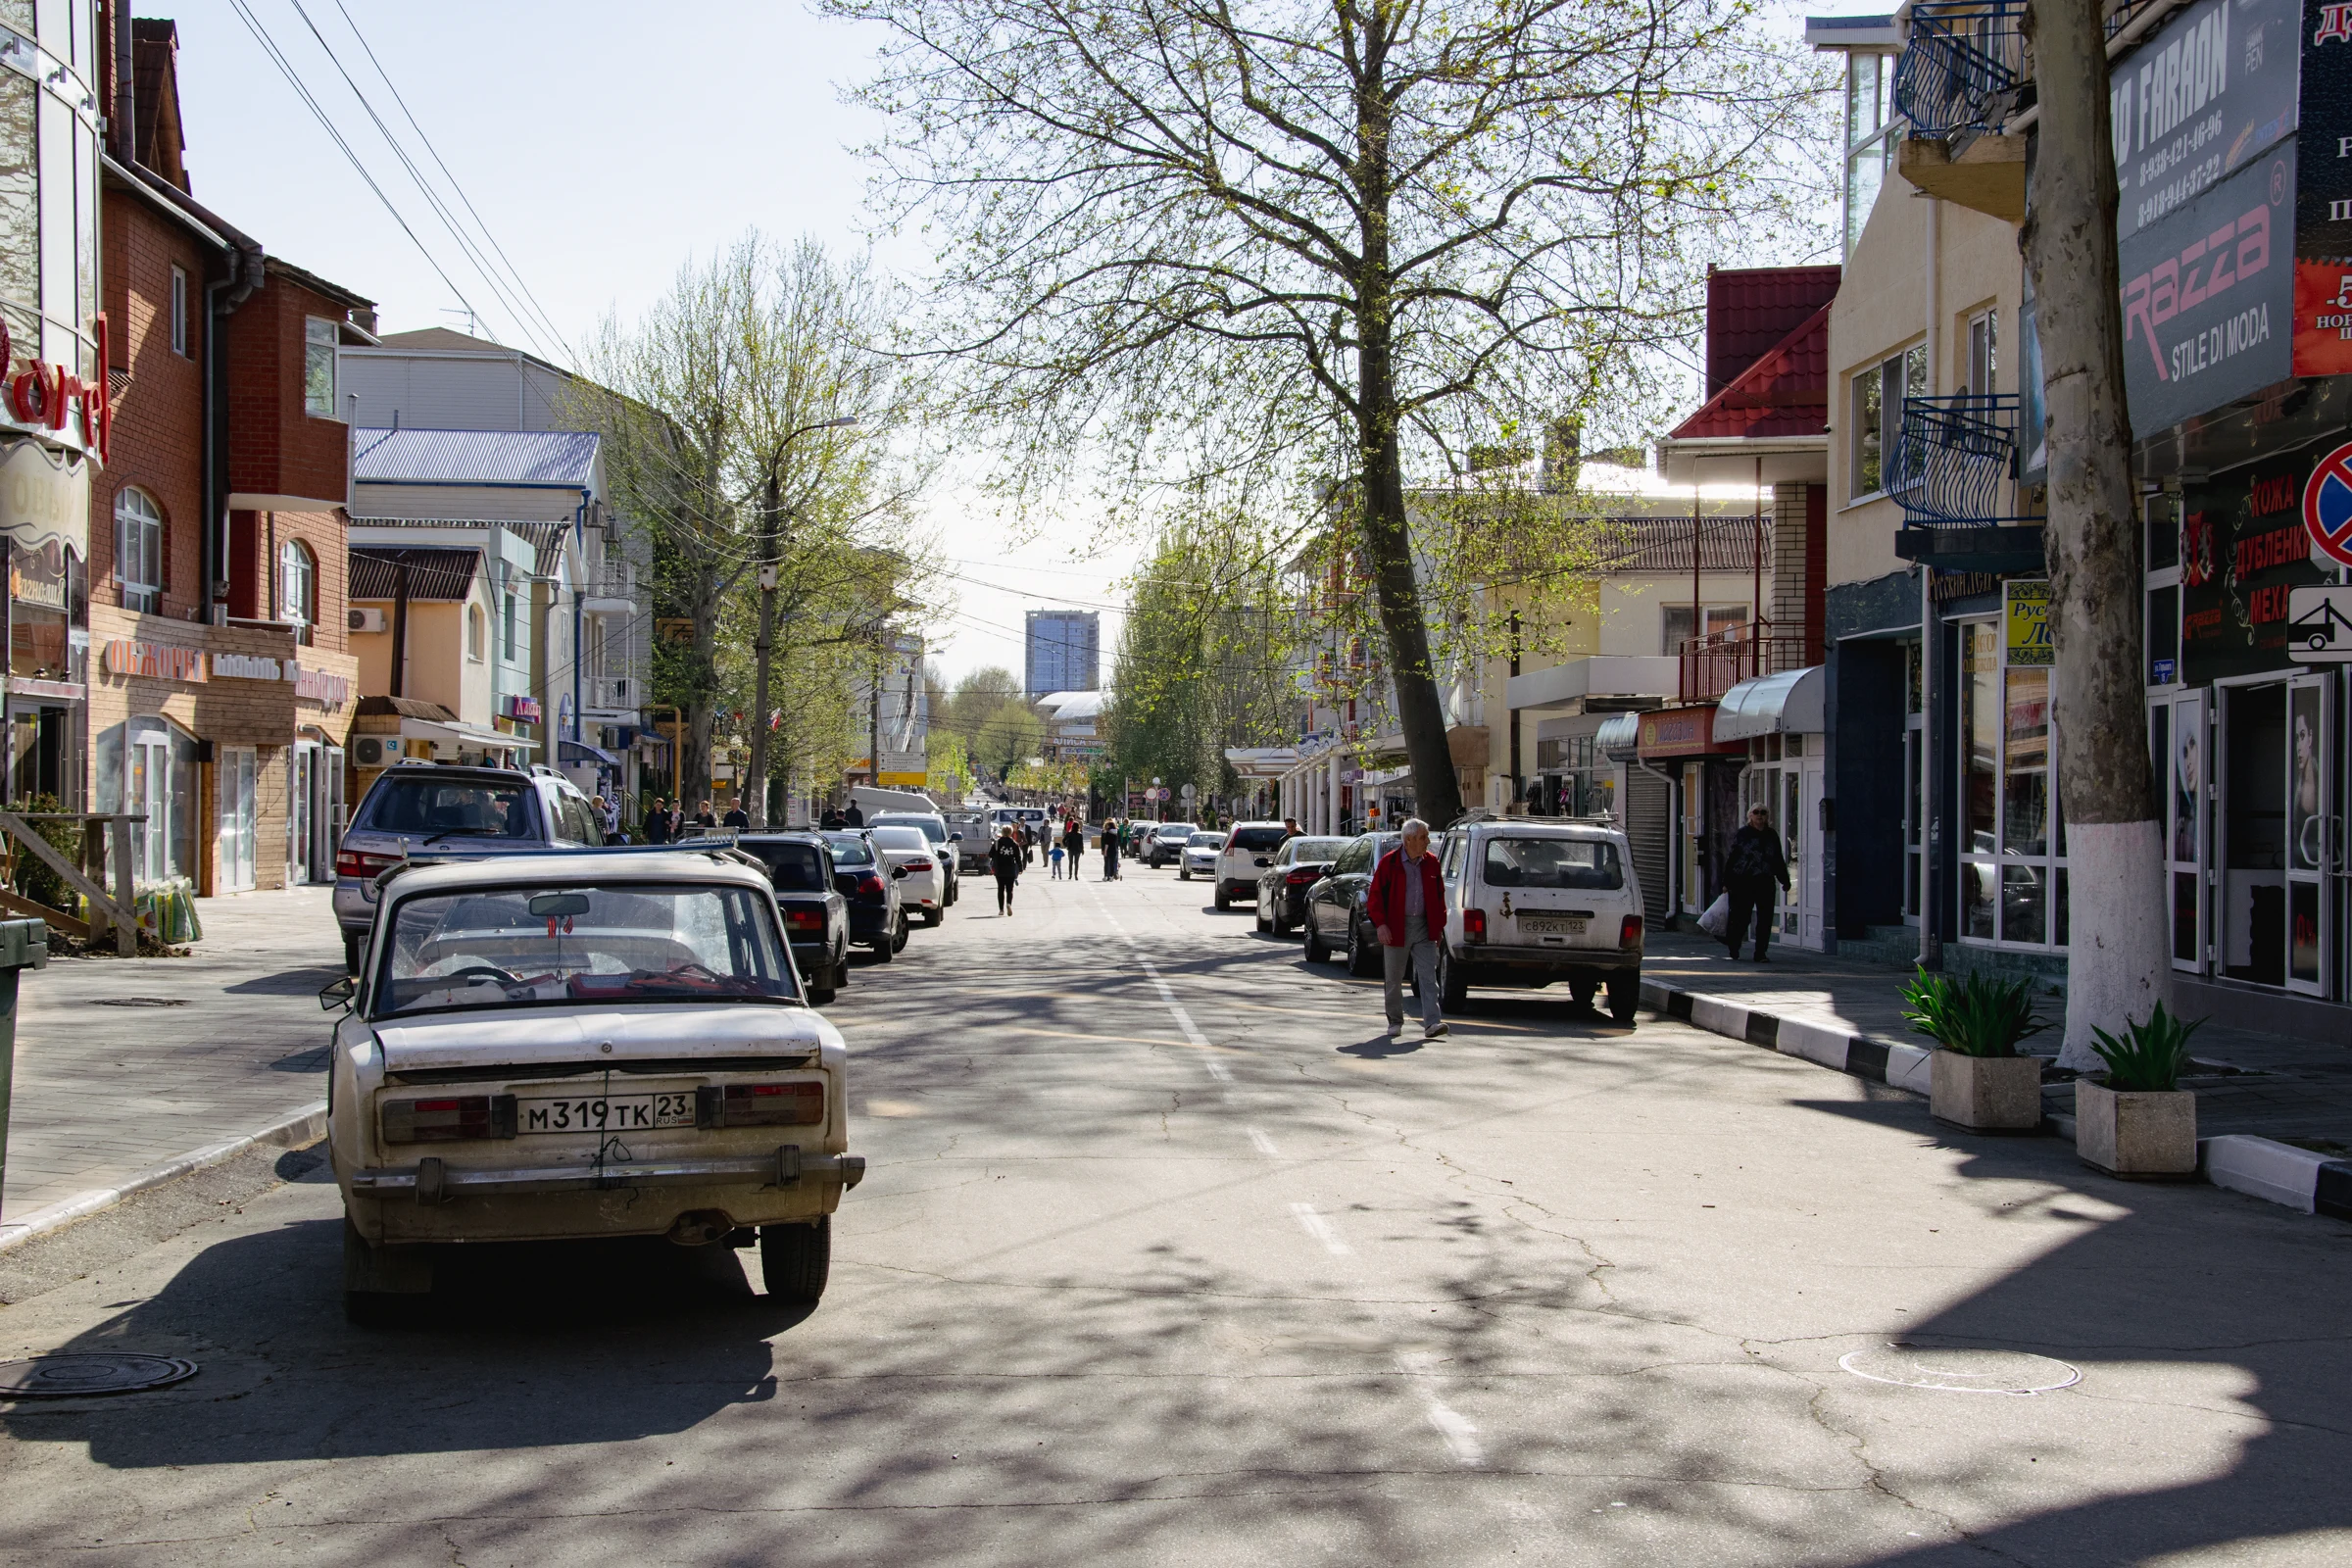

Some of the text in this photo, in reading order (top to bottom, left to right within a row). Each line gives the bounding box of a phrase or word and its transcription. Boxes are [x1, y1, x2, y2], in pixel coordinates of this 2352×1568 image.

[2138, 0, 2229, 152] FARAON
[2245, 43, 2263, 75] PEN
[2139, 110, 2223, 187] 8-938-421-46-96
[2137, 154, 2220, 227] 8-918-944-37-22
[2121, 204, 2271, 381] Razza
[2172, 302, 2270, 383] STILE DI MODA
[2251, 473, 2294, 517] КОЖА
[2235, 523, 2311, 581] ДУБЛЕНКИ
[2013, 602, 2047, 621] Рус
[108, 639, 207, 683] ОБЖОРКА
[1525, 921, 1585, 932] С892КТ 123
[528, 1095, 687, 1130] М319ТК 23
